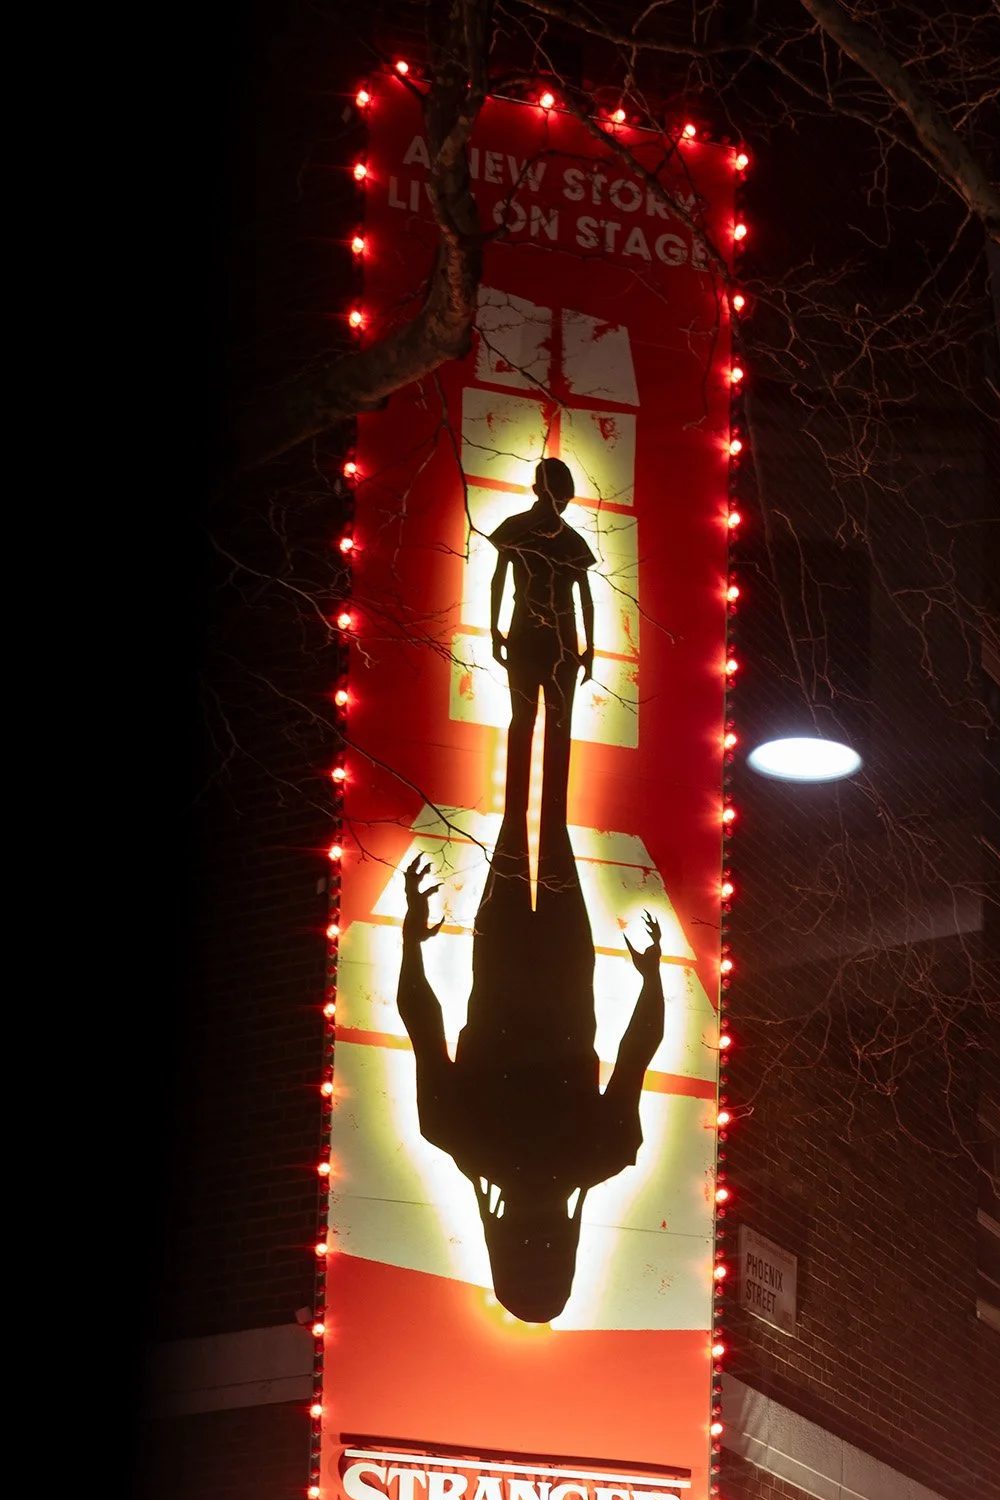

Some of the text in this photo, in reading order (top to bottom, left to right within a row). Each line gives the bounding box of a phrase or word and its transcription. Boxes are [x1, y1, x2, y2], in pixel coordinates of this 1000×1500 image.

[492, 198, 560, 241] ON
[746, 1252, 783, 1294] PHOENIX
[745, 1279, 777, 1315] STREET
